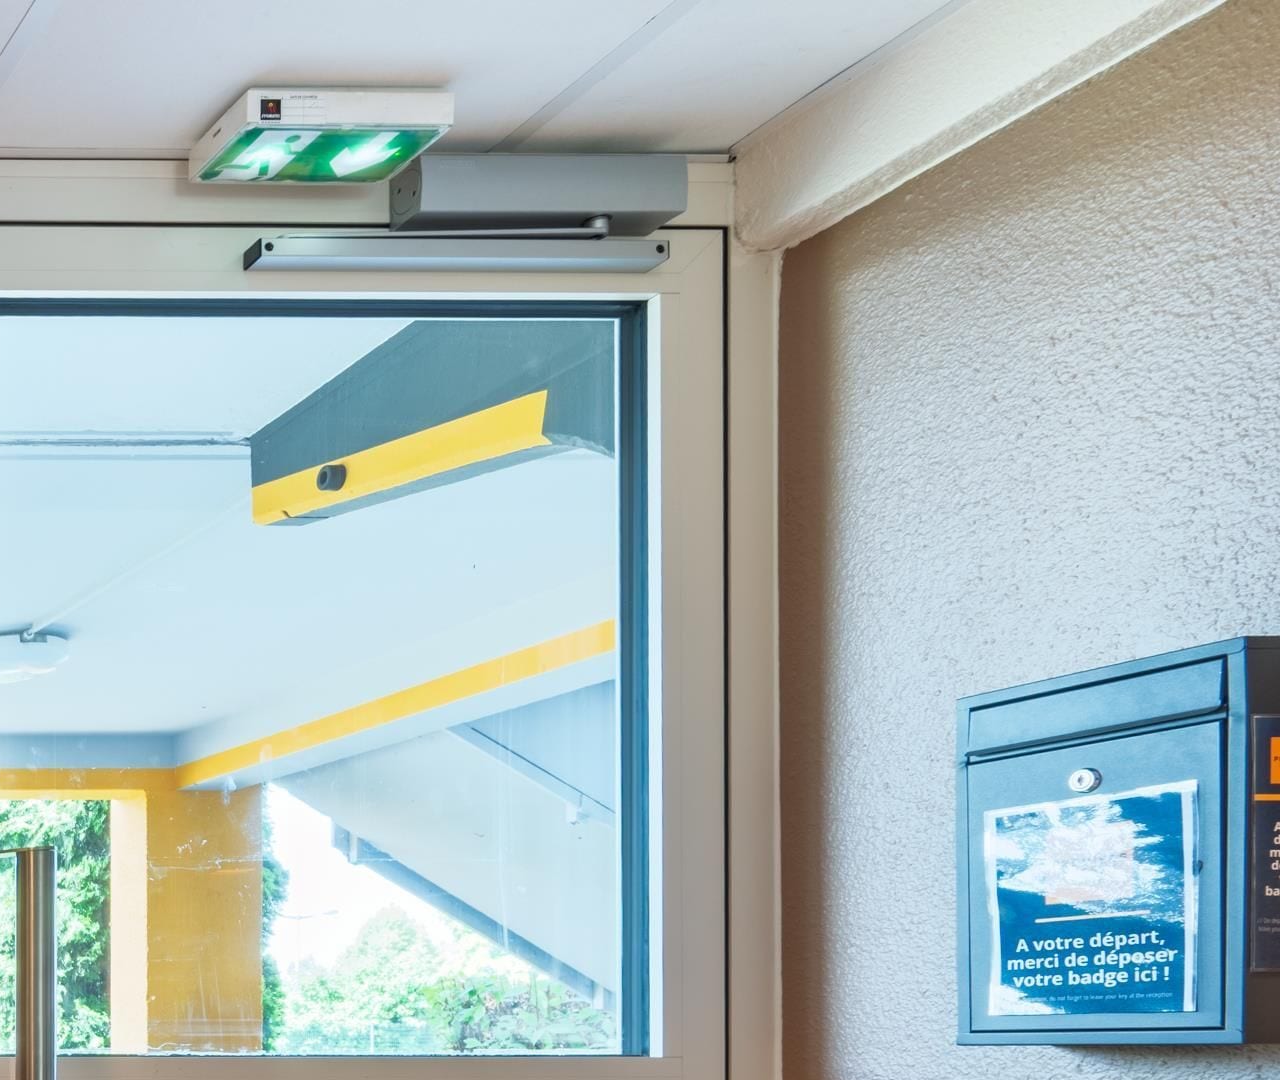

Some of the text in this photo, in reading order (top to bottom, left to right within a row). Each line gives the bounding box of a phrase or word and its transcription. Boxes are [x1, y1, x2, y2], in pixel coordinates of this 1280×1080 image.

[1016, 930, 1165, 952] A votre départ,
[1007, 949, 1178, 970] merci de déposer
[1013, 966, 1170, 988] votre badge ici !
